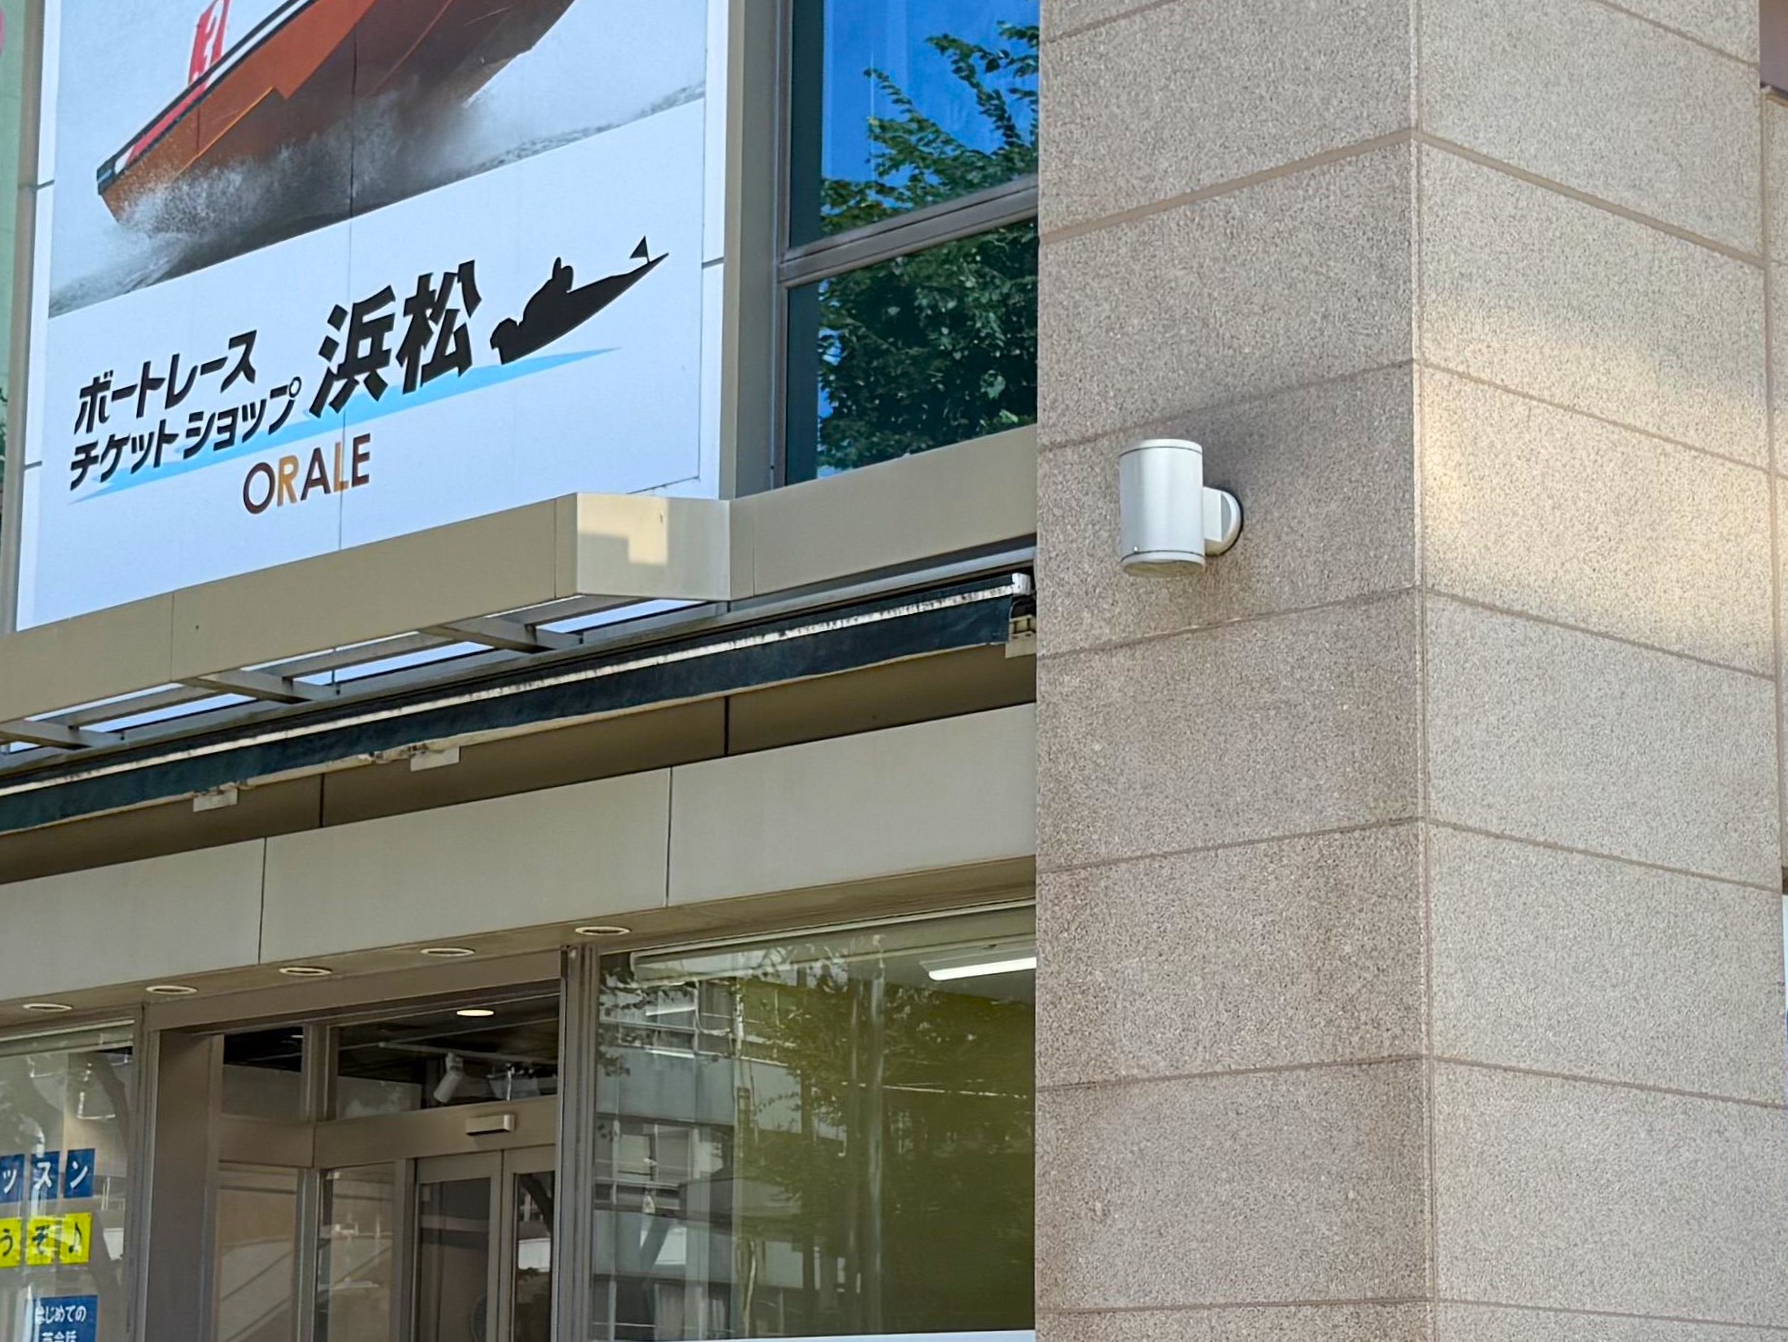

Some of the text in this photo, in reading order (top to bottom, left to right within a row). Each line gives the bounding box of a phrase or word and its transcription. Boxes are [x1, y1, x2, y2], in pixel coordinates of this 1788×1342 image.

[73, 328, 258, 436] ボートレース
[308, 259, 483, 419] 浜松
[69, 374, 302, 491] チケットショップ
[242, 432, 372, 516] ORALE
